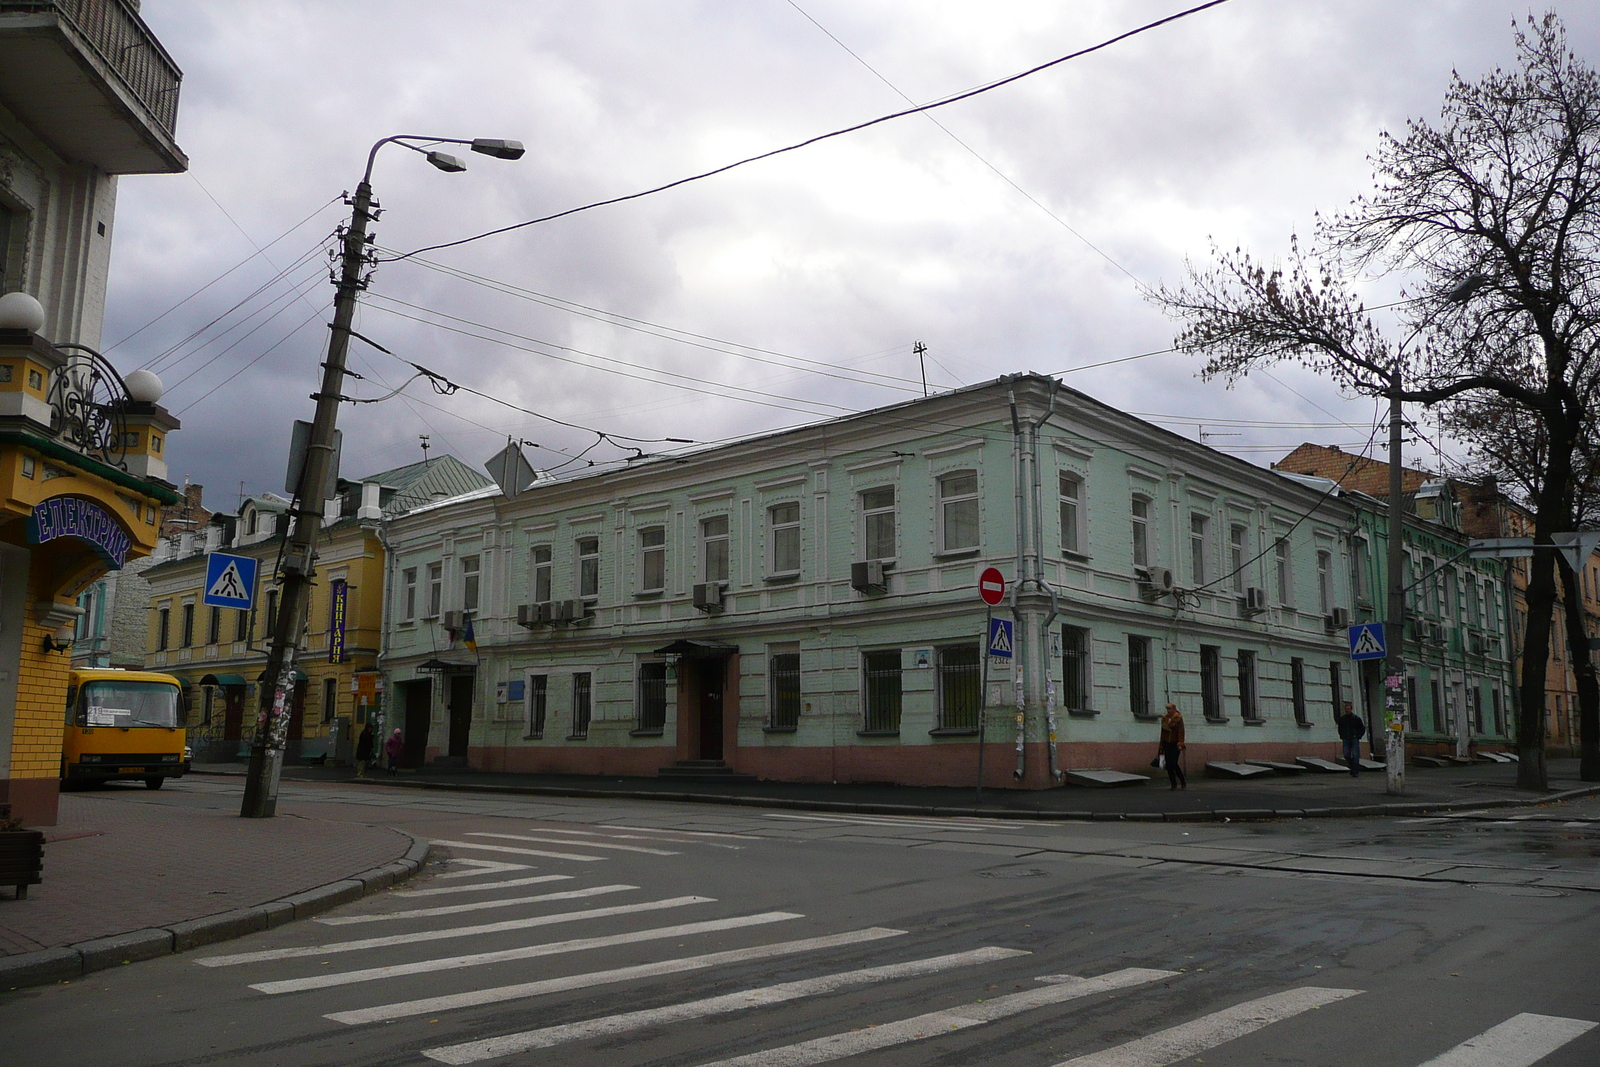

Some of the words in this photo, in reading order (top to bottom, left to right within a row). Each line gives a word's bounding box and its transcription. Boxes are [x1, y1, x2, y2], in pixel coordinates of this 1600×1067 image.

[35, 497, 132, 570] ЕЛЕКТРИК
[332, 594, 344, 663] КНИГАРНЯ
[88, 707, 103, 715] 219
